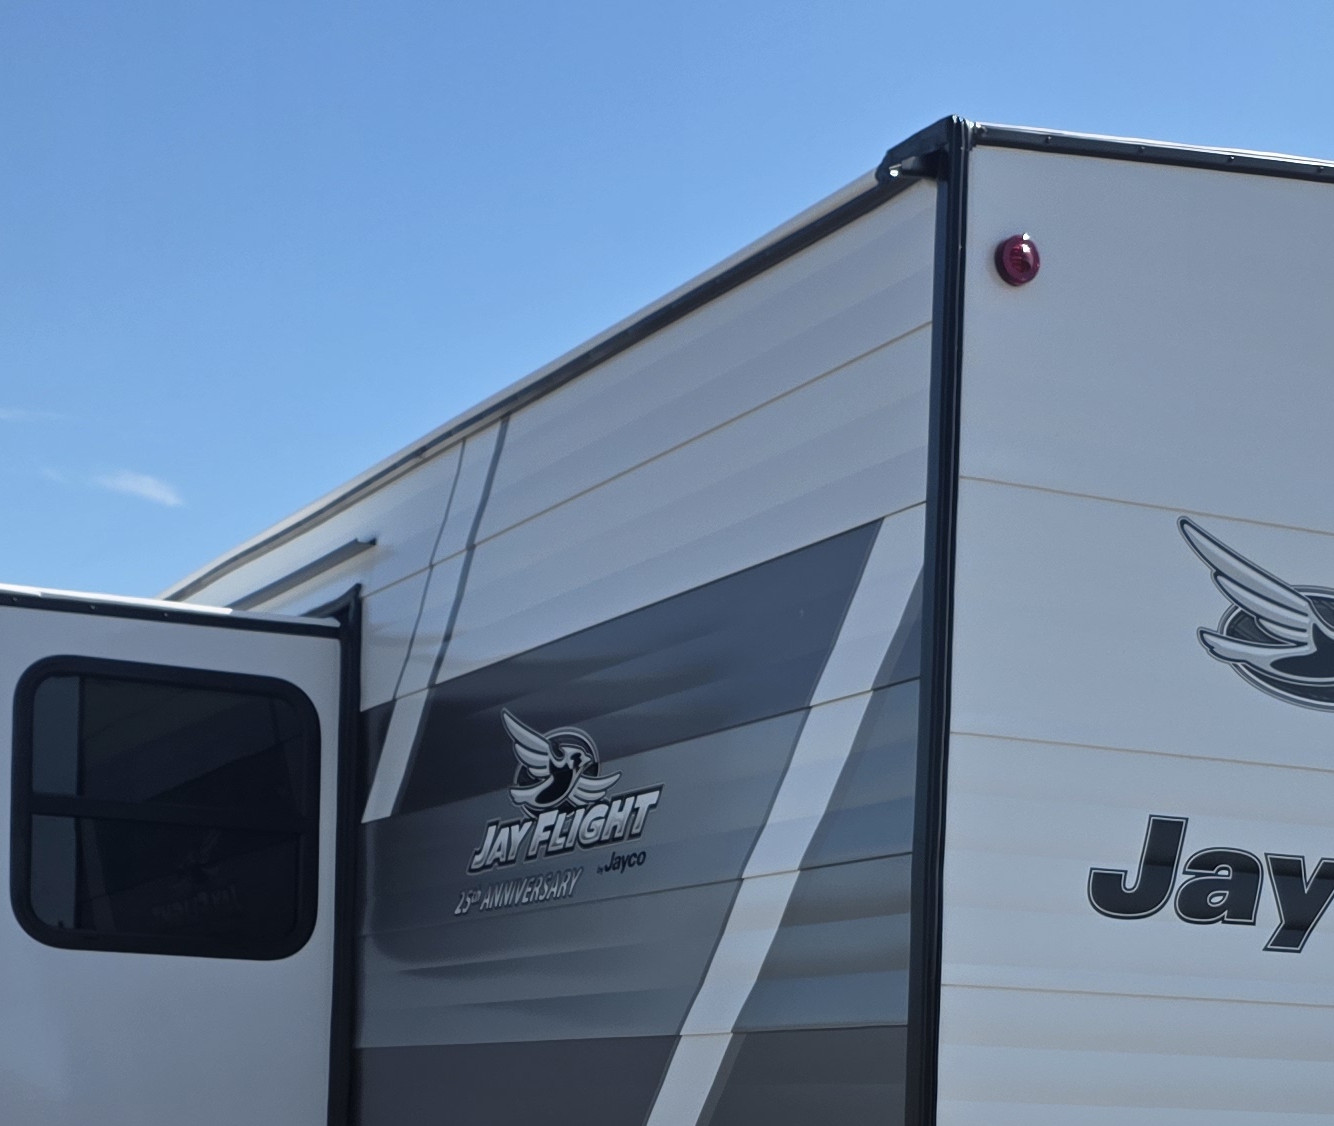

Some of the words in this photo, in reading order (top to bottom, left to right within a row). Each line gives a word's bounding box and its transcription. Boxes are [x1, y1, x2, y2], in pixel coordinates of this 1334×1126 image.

[468, 819, 533, 874] JAY
[526, 785, 663, 861] FLIGHT
[604, 851, 646, 874] Jayco
[480, 867, 583, 911] ANNIVERSARY
